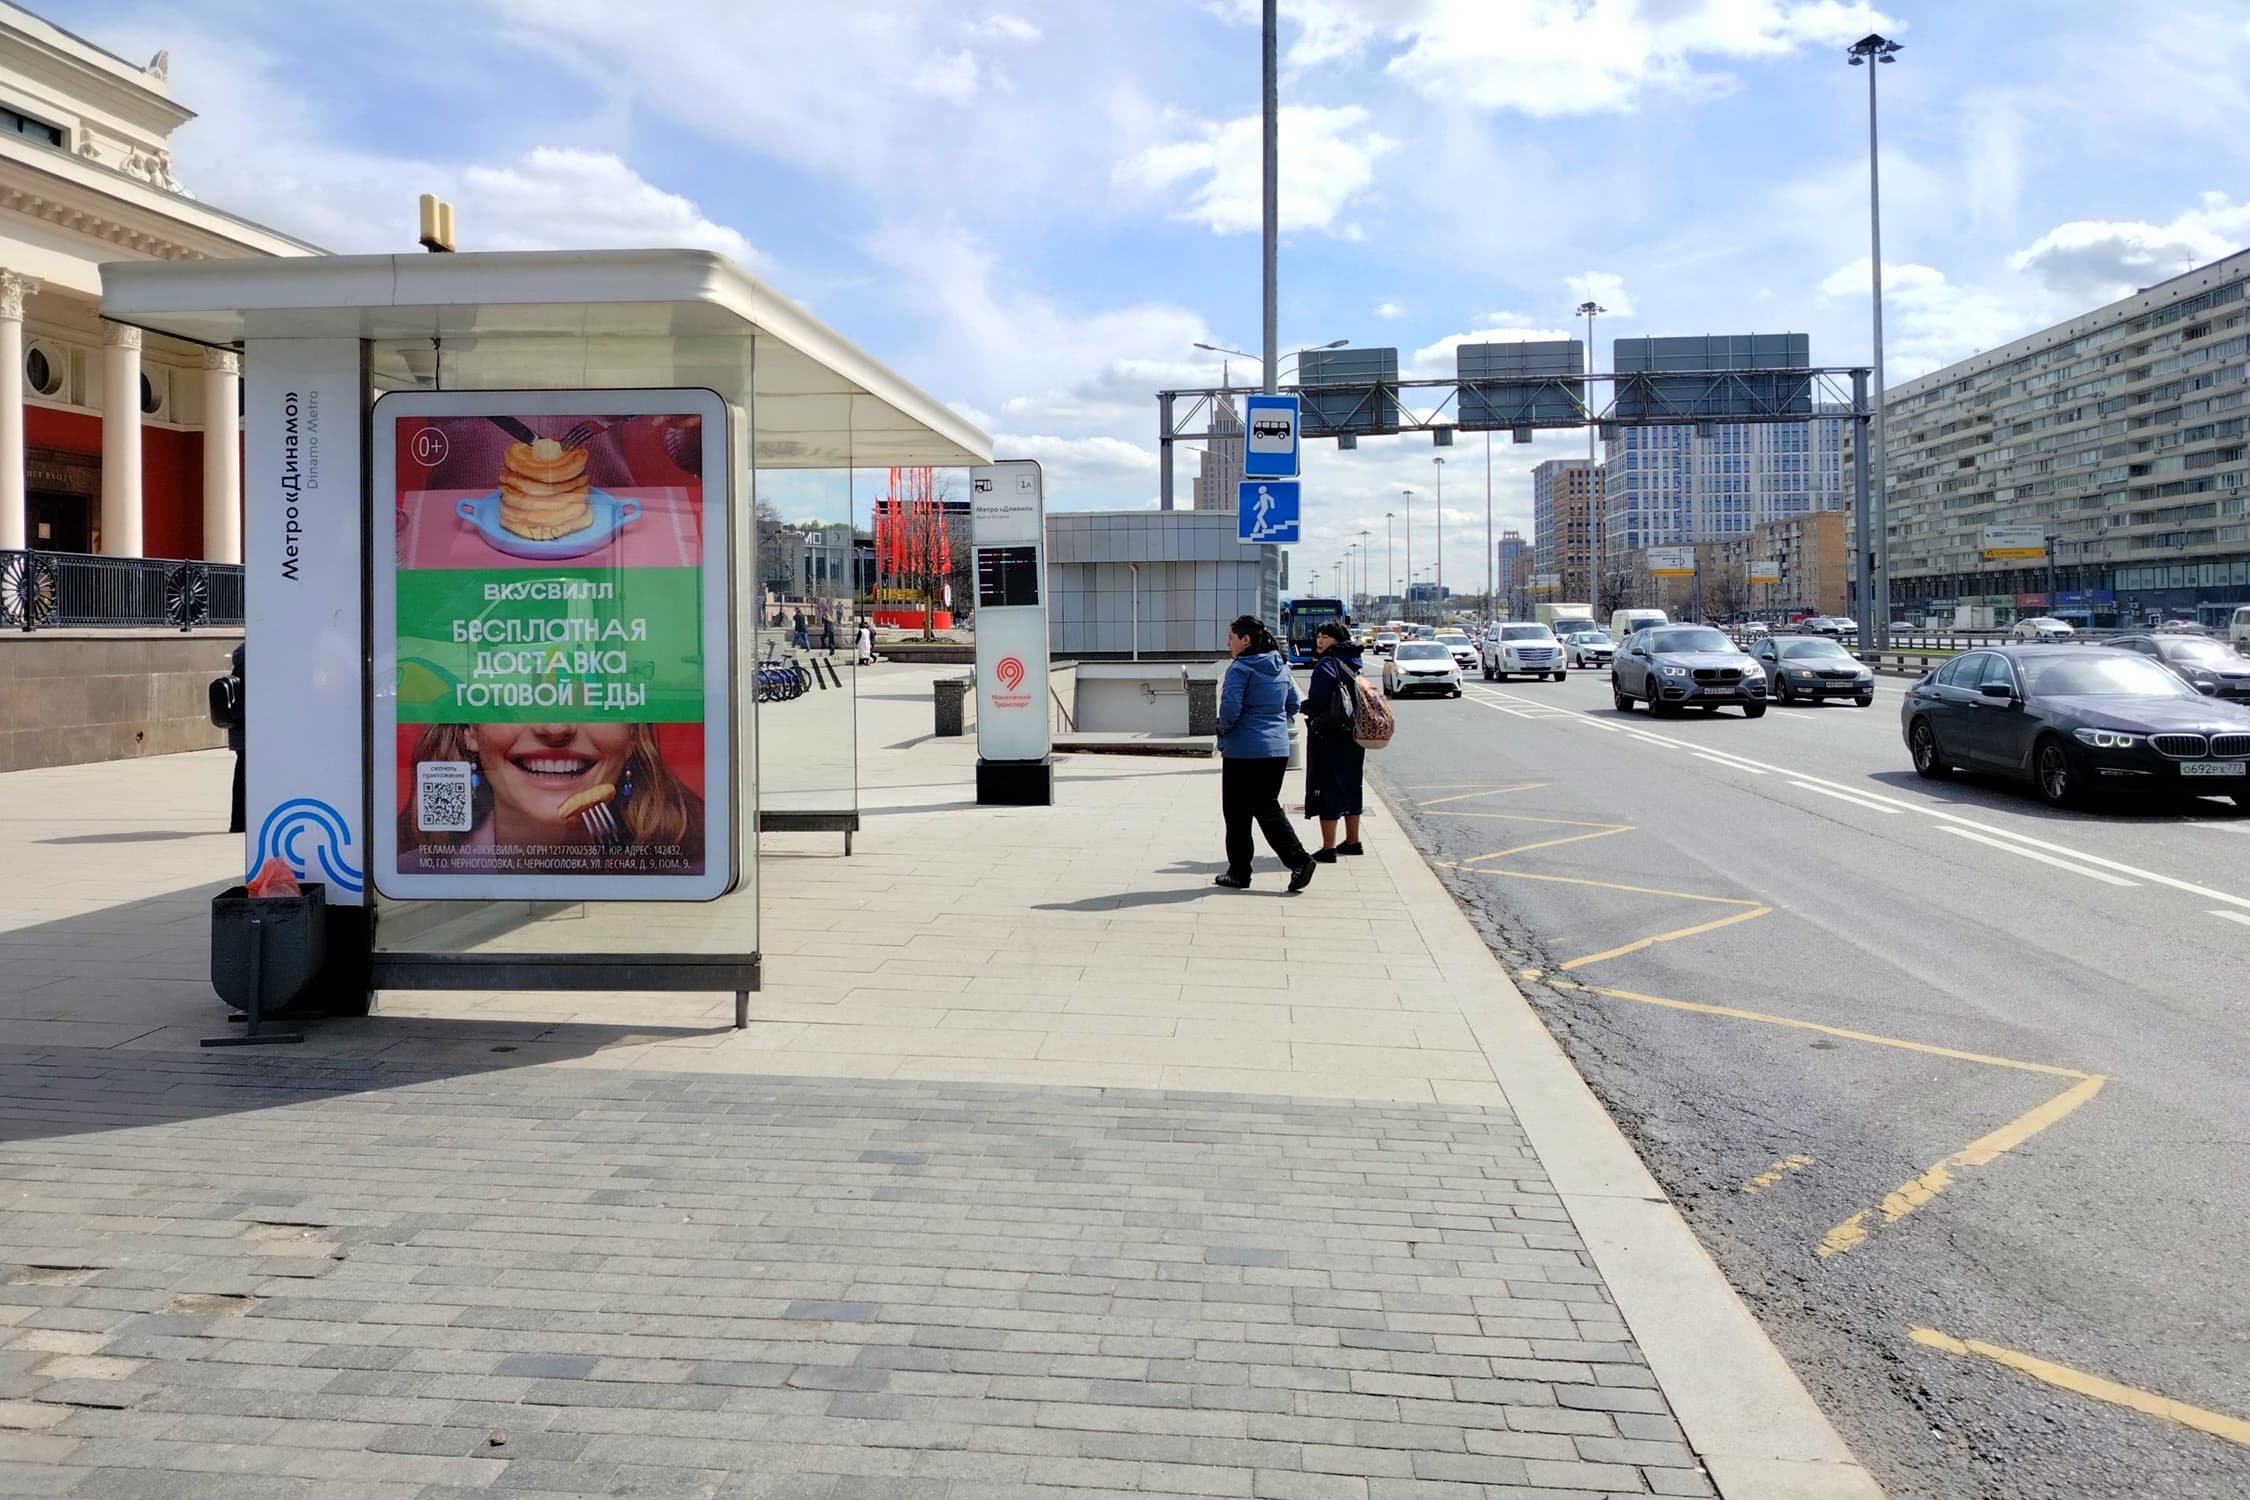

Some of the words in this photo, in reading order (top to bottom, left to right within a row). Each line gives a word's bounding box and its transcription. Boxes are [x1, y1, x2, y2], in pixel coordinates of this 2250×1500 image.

[307, 390, 318, 433] Metro
[281, 391, 301, 502] «Динамо»
[307, 437, 318, 489] Dinamo
[419, 436, 443, 457] 0+
[282, 506, 302, 581] Метро
[484, 582, 613, 600] ВКУСВИЛЛ
[456, 678, 573, 707] ГОТОВОЙ
[583, 682, 645, 711] ЕДЫ
[419, 858, 435, 869] МО,
[451, 858, 515, 869] ЧЕРНОГОЛОВКА,
[524, 858, 589, 869] ЧЕРНОГОЛОВКА,
[603, 859, 638, 870] ЛЕСНАЯ,
[526, 845, 548, 855] ОГРН
[624, 845, 652, 856] АДРЕС:
[653, 845, 683, 856] 142432,
